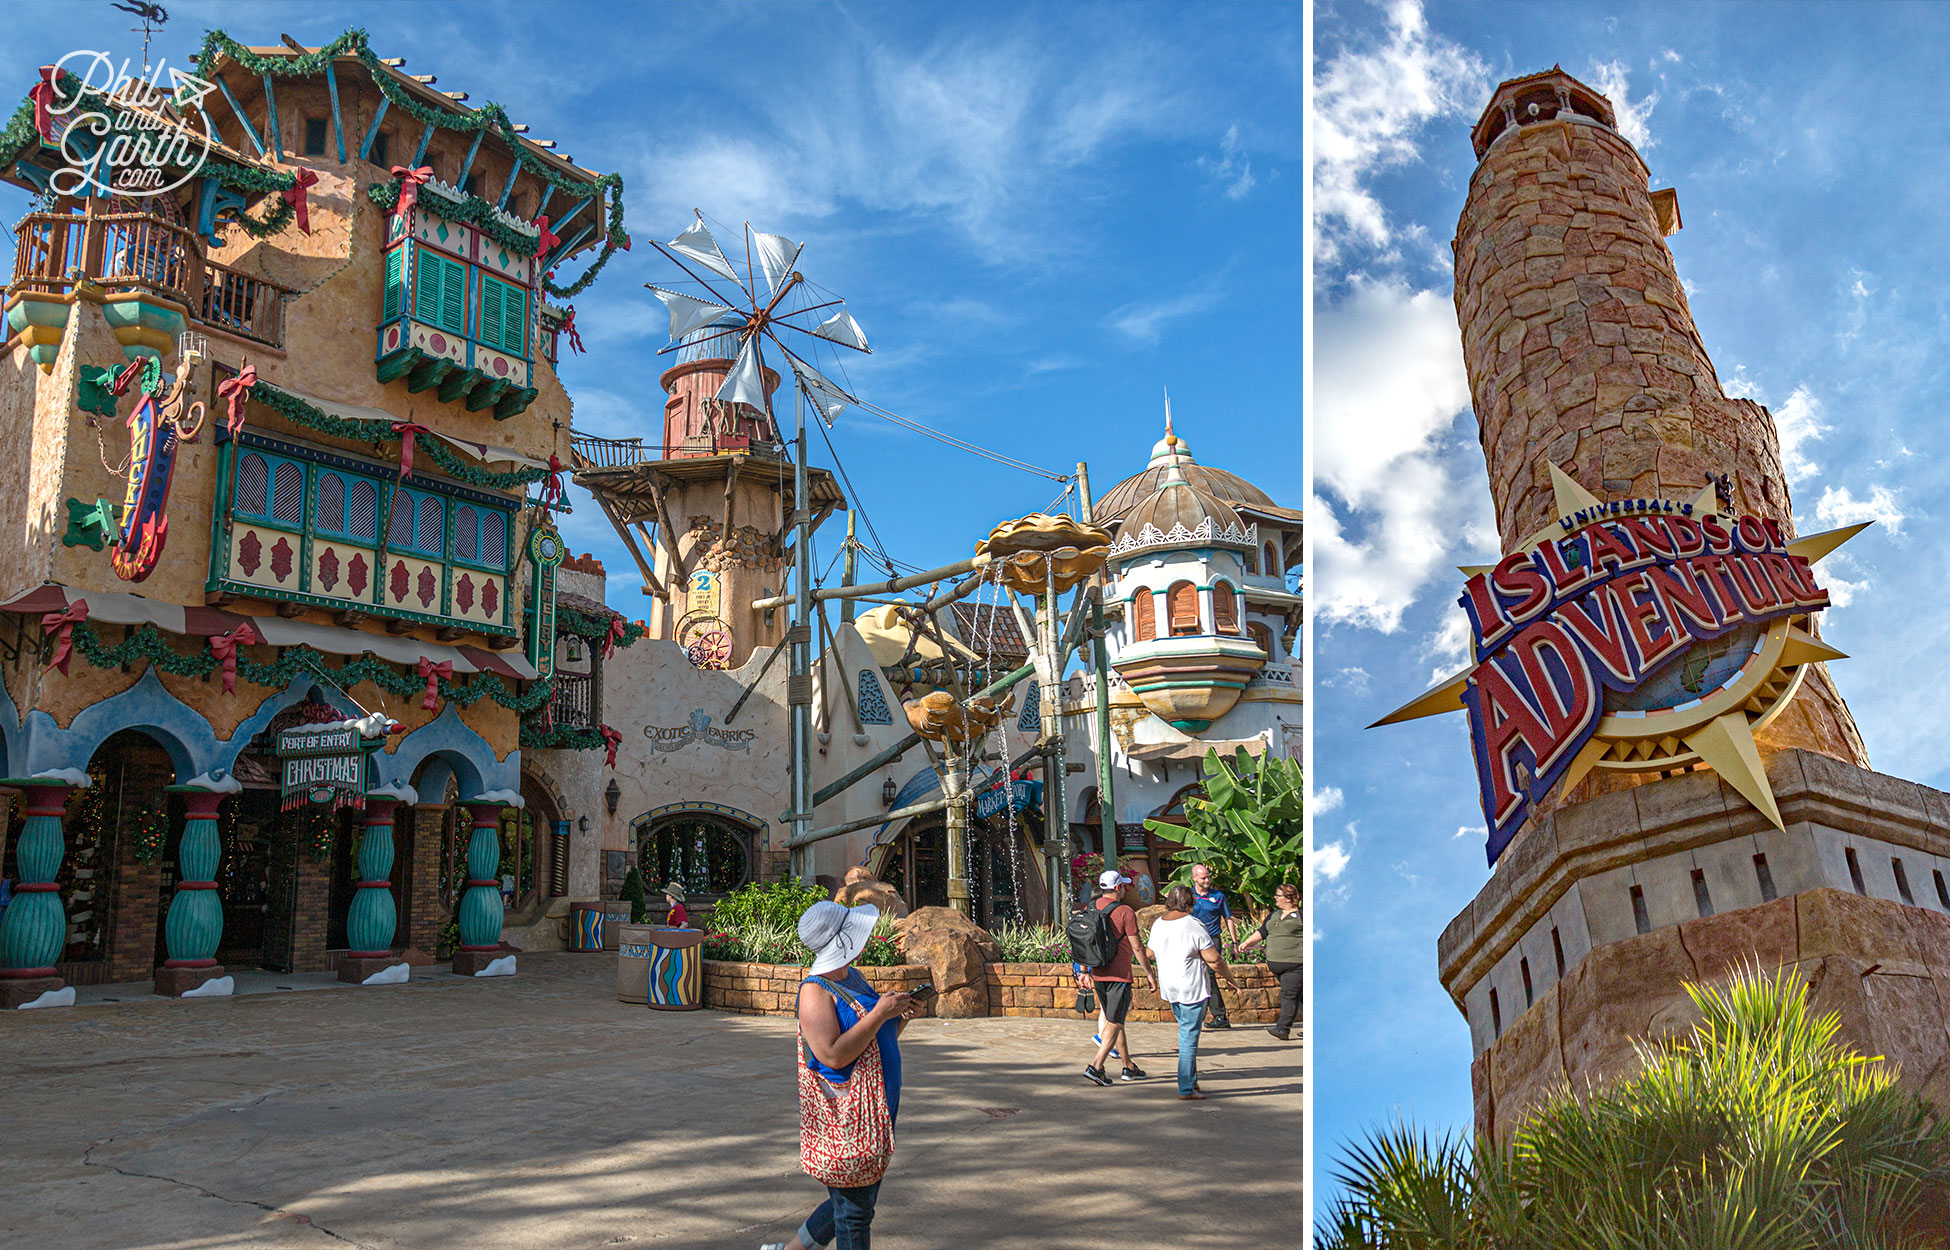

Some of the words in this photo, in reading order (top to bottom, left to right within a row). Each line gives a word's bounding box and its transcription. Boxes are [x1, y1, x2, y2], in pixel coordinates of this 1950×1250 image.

[120, 413, 150, 527] LUCKY
[1558, 498, 1693, 531] UNIVERSAL'S
[114, 531, 151, 579] MONKEY
[697, 575, 711, 591] 2
[1463, 514, 1734, 649] ISLANDS
[1733, 514, 1787, 553] OF
[540, 566, 553, 651] JEWELRY
[1469, 552, 1830, 832] ADVENTURE
[282, 736, 306, 750] PORT
[307, 735, 319, 748] OF
[321, 731, 352, 747] ENTRY
[643, 725, 690, 740] EXOTIC
[708, 726, 755, 742] FABRICS
[287, 756, 359, 786] CHRISTMAS
[977, 790, 1005, 817] MARKET
